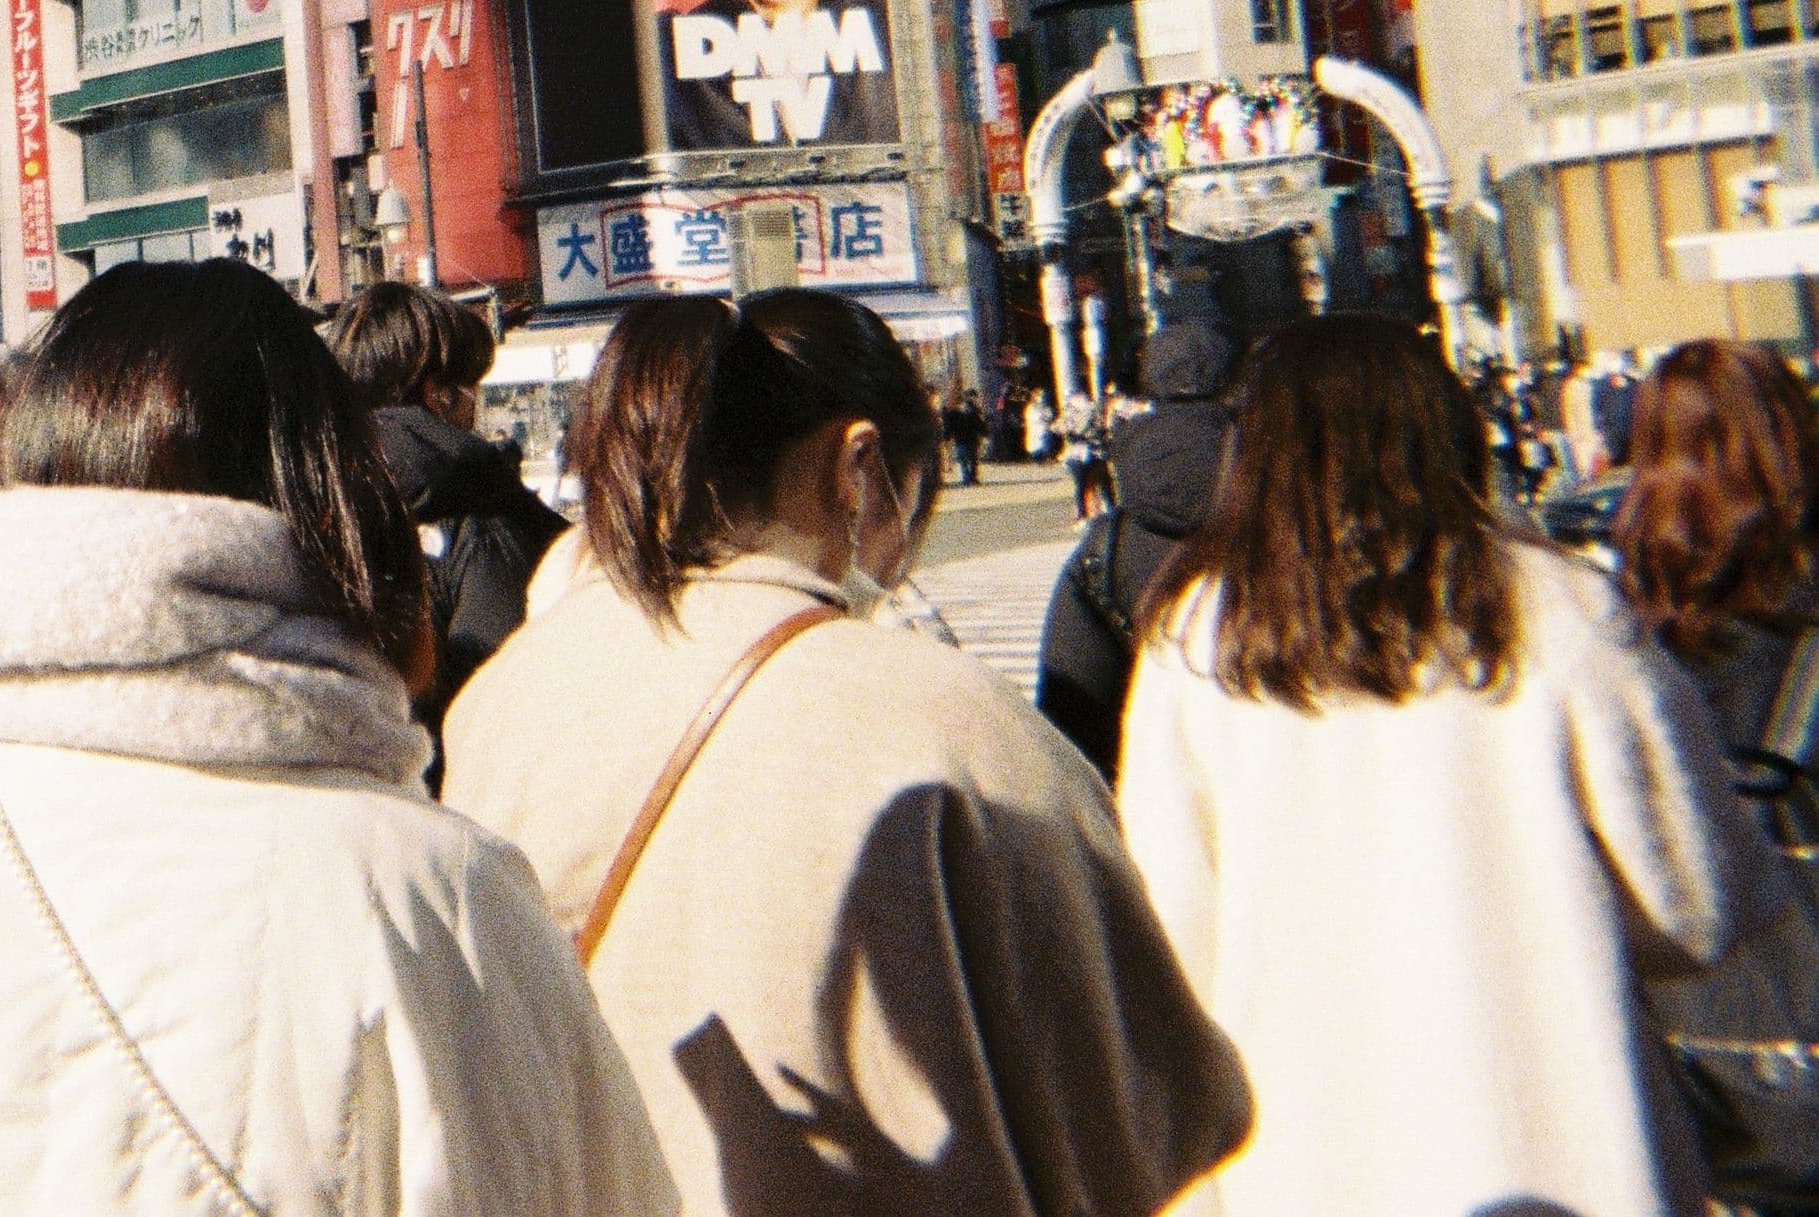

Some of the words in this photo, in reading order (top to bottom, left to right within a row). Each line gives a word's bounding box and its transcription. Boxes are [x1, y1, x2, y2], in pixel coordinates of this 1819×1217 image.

[672, 7, 883, 79] DMM
[732, 76, 831, 142] TV
[556, 201, 885, 281] 大盛堂店
